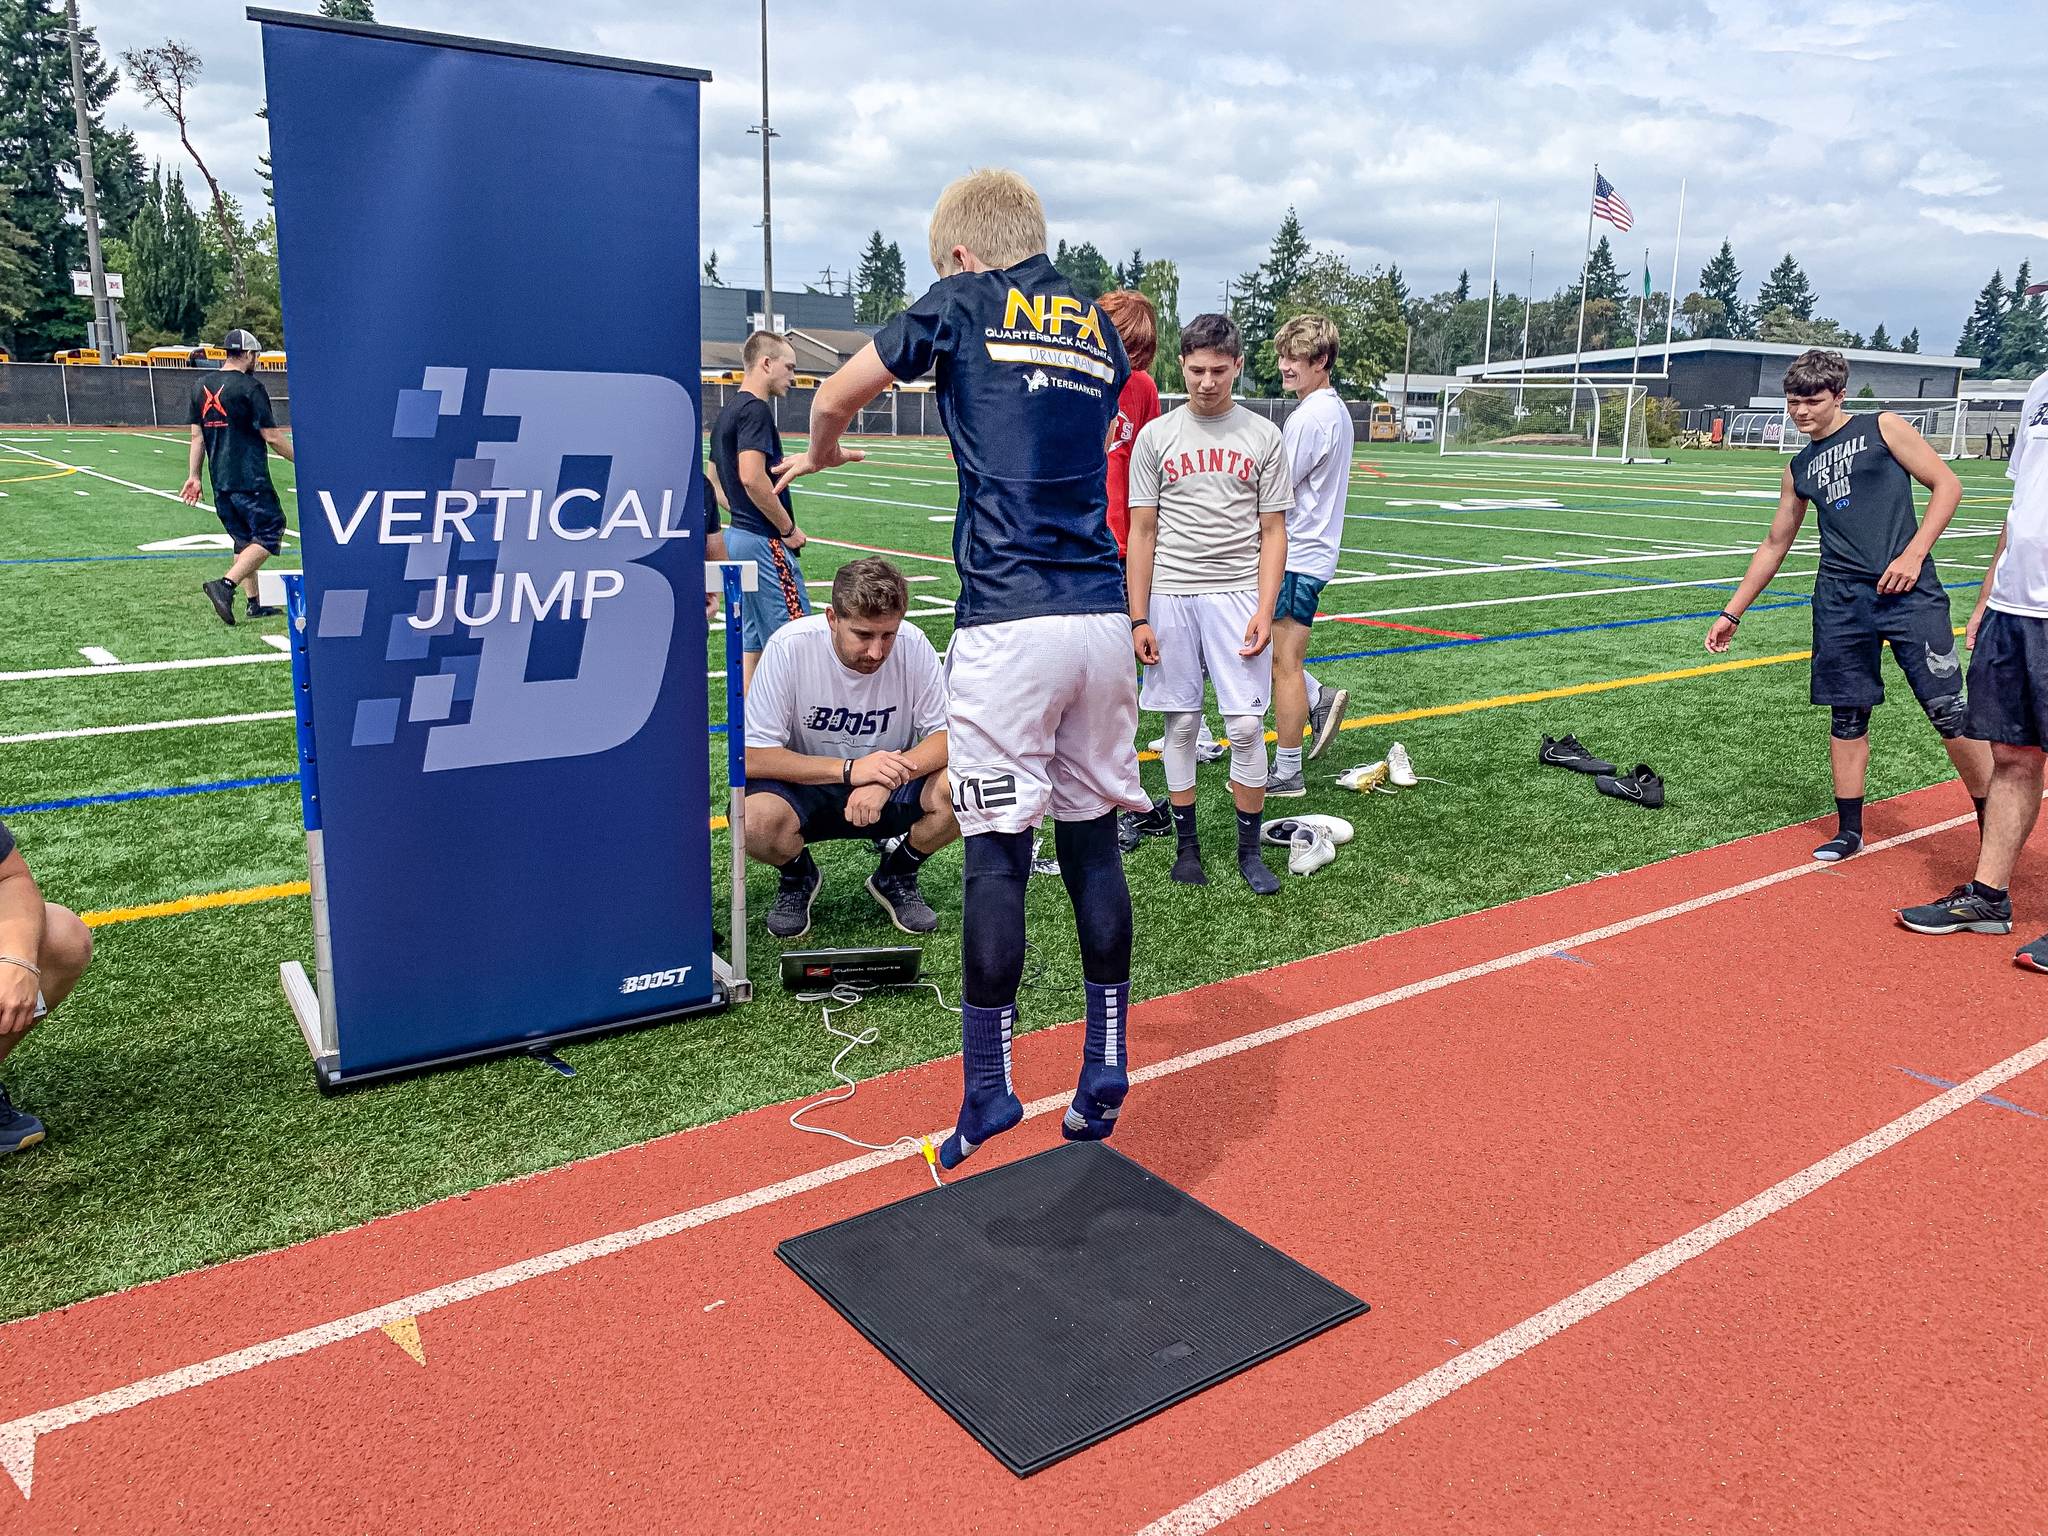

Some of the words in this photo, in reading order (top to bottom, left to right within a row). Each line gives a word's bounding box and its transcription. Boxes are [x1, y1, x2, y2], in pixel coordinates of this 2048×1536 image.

[1003, 288, 1107, 350] NFA
[984, 328, 1074, 346] QUARTERBACK
[1051, 376, 1102, 398] TEREMARKETS
[1163, 447, 1255, 484] SAINTS
[1817, 466, 1831, 489] IS
[1833, 455, 1854, 481] MY
[1825, 476, 1851, 505] JOB
[317, 488, 691, 545] VERTICAL
[406, 569, 626, 631] JUMP
[803, 705, 897, 736] BOOST
[619, 965, 692, 994] BOOST
